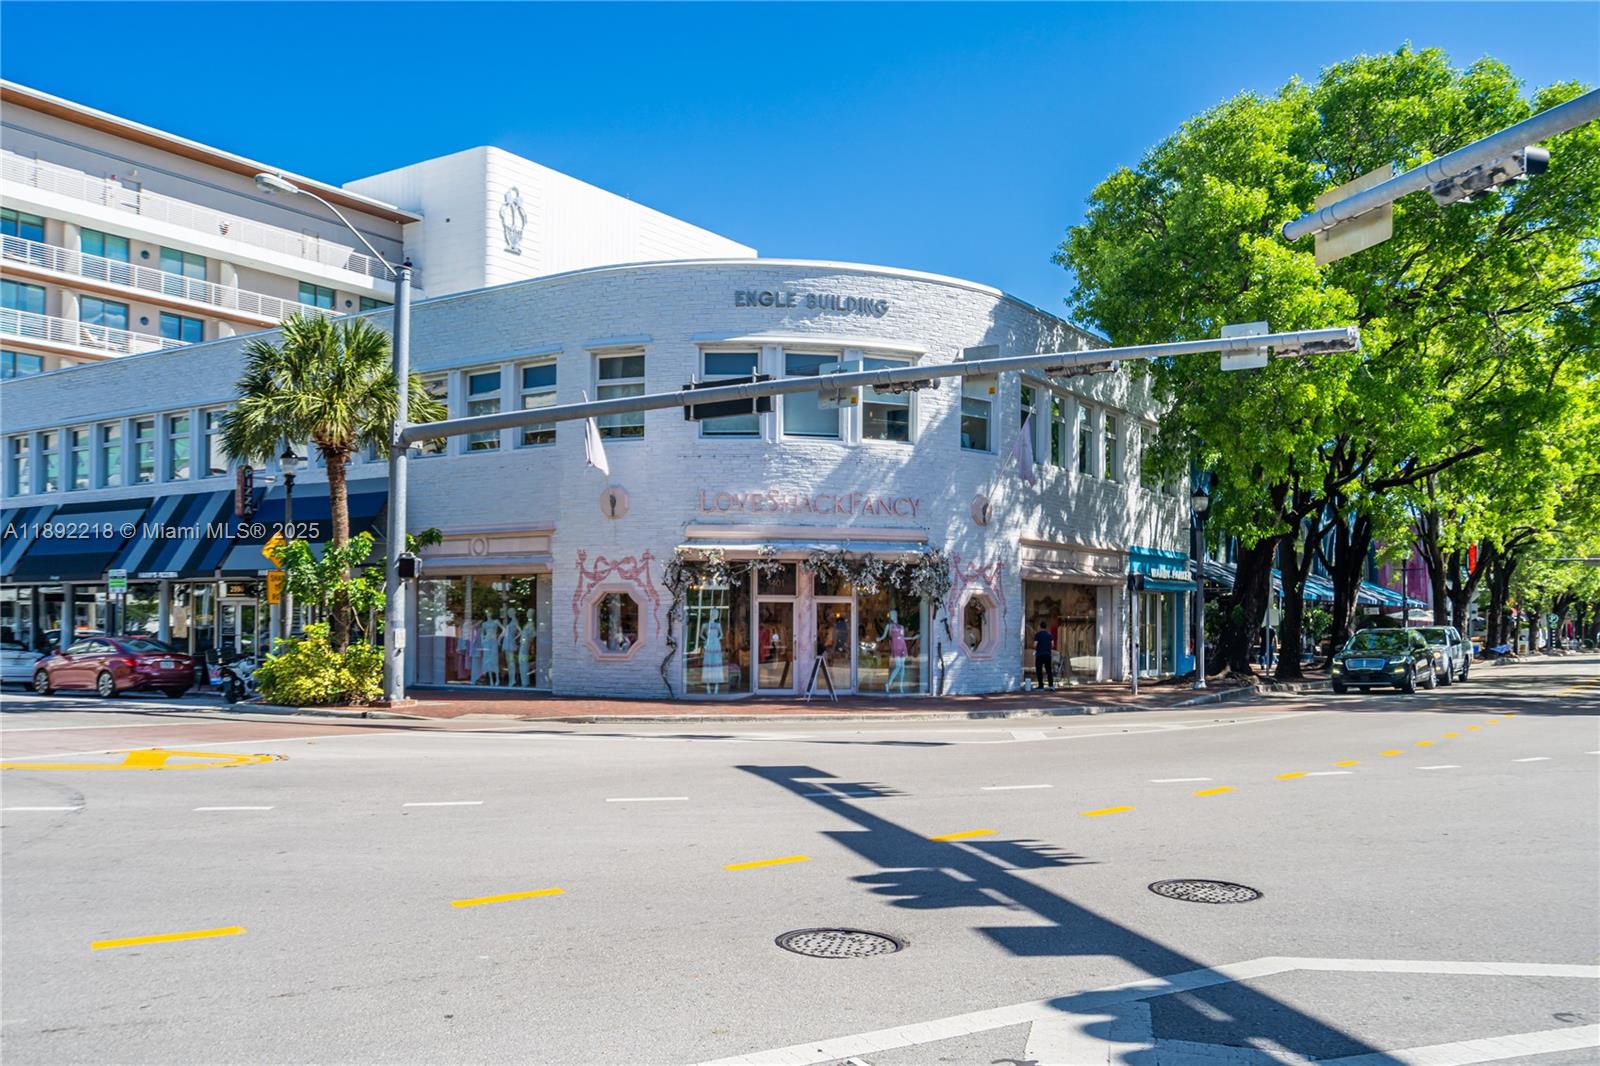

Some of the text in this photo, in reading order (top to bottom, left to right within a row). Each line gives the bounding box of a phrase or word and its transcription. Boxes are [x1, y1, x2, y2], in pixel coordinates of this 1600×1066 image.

[735, 290, 890, 318] ENGLE BUILDING
[244, 468, 252, 514] PIZZA
